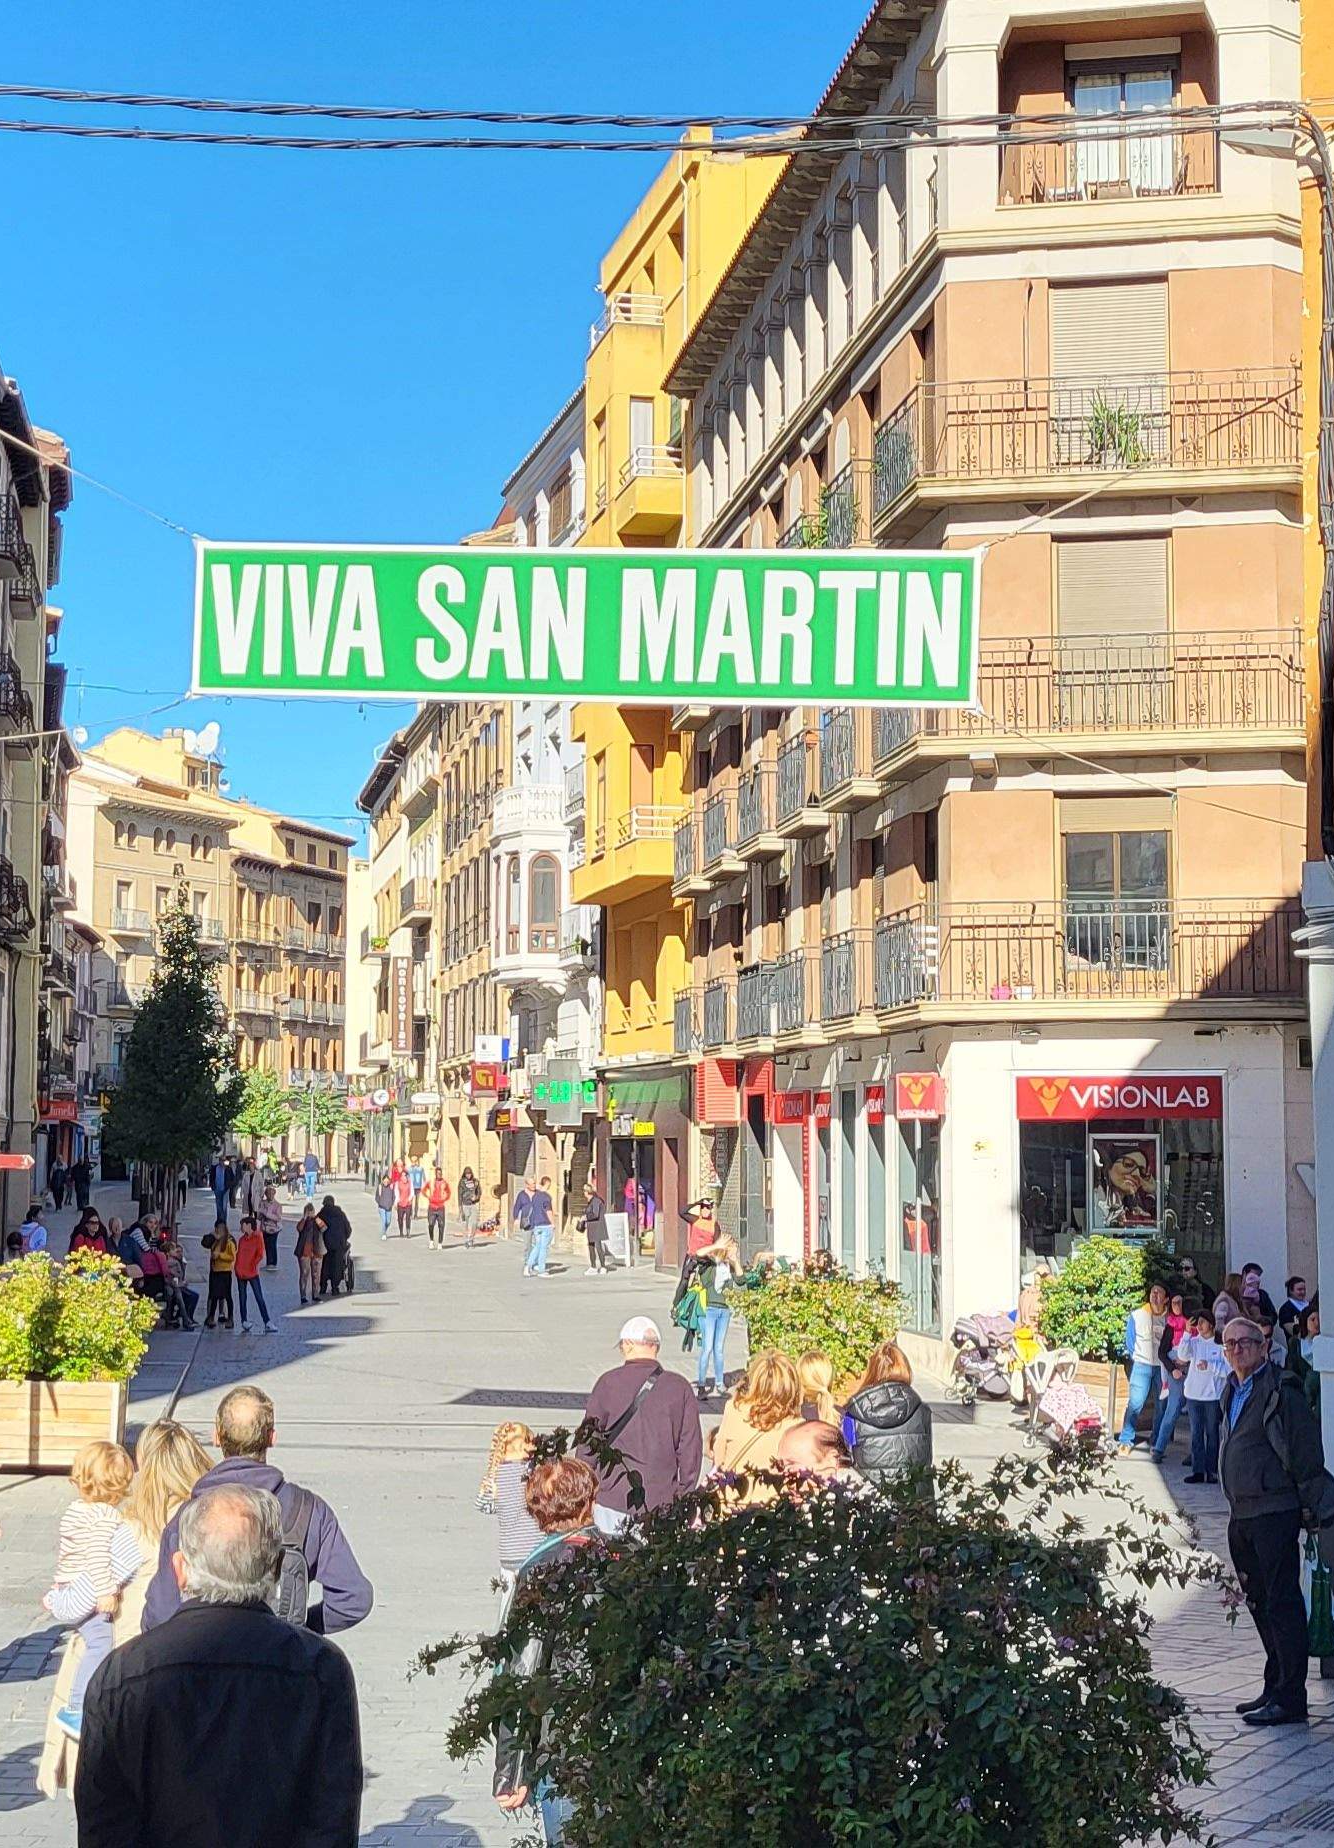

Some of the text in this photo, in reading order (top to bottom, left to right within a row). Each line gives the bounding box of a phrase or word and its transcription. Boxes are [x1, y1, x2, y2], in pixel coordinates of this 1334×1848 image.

[210, 563, 962, 689] VIVA SAN MARTIN
[1068, 1084, 1211, 1109] VISIONLAB
